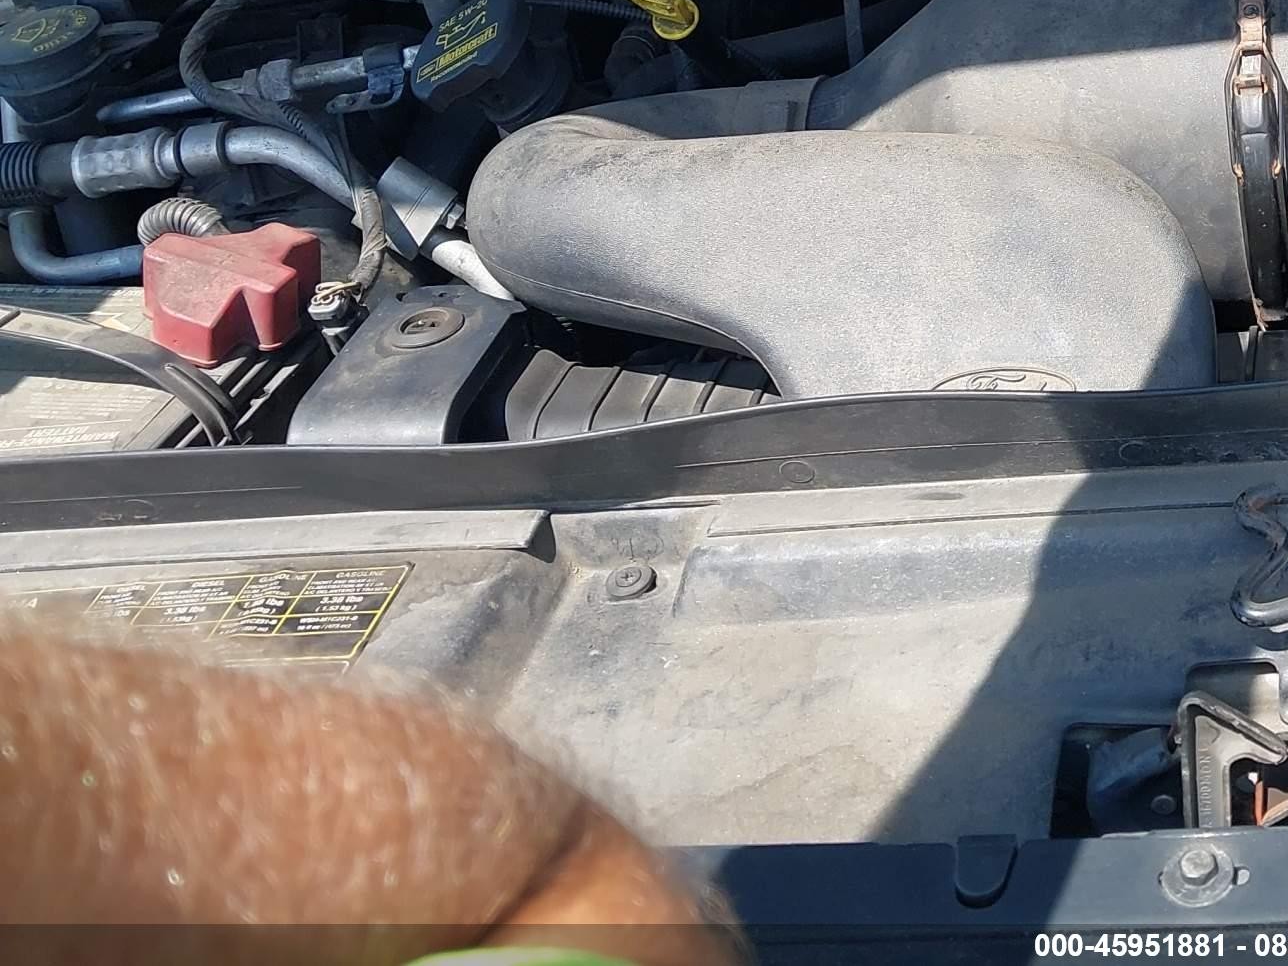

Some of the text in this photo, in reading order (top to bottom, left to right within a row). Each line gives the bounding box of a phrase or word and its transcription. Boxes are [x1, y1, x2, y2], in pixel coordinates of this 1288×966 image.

[438, 15, 457, 32] SAE
[439, 27, 495, 68] Motorcraft
[23, 425, 90, 438] BATTERY
[258, 574, 308, 583] GASOLNE
[335, 570, 386, 580] GASOLINE
[117, 585, 145, 593] DIESEL
[345, 595, 364, 603] lbs
